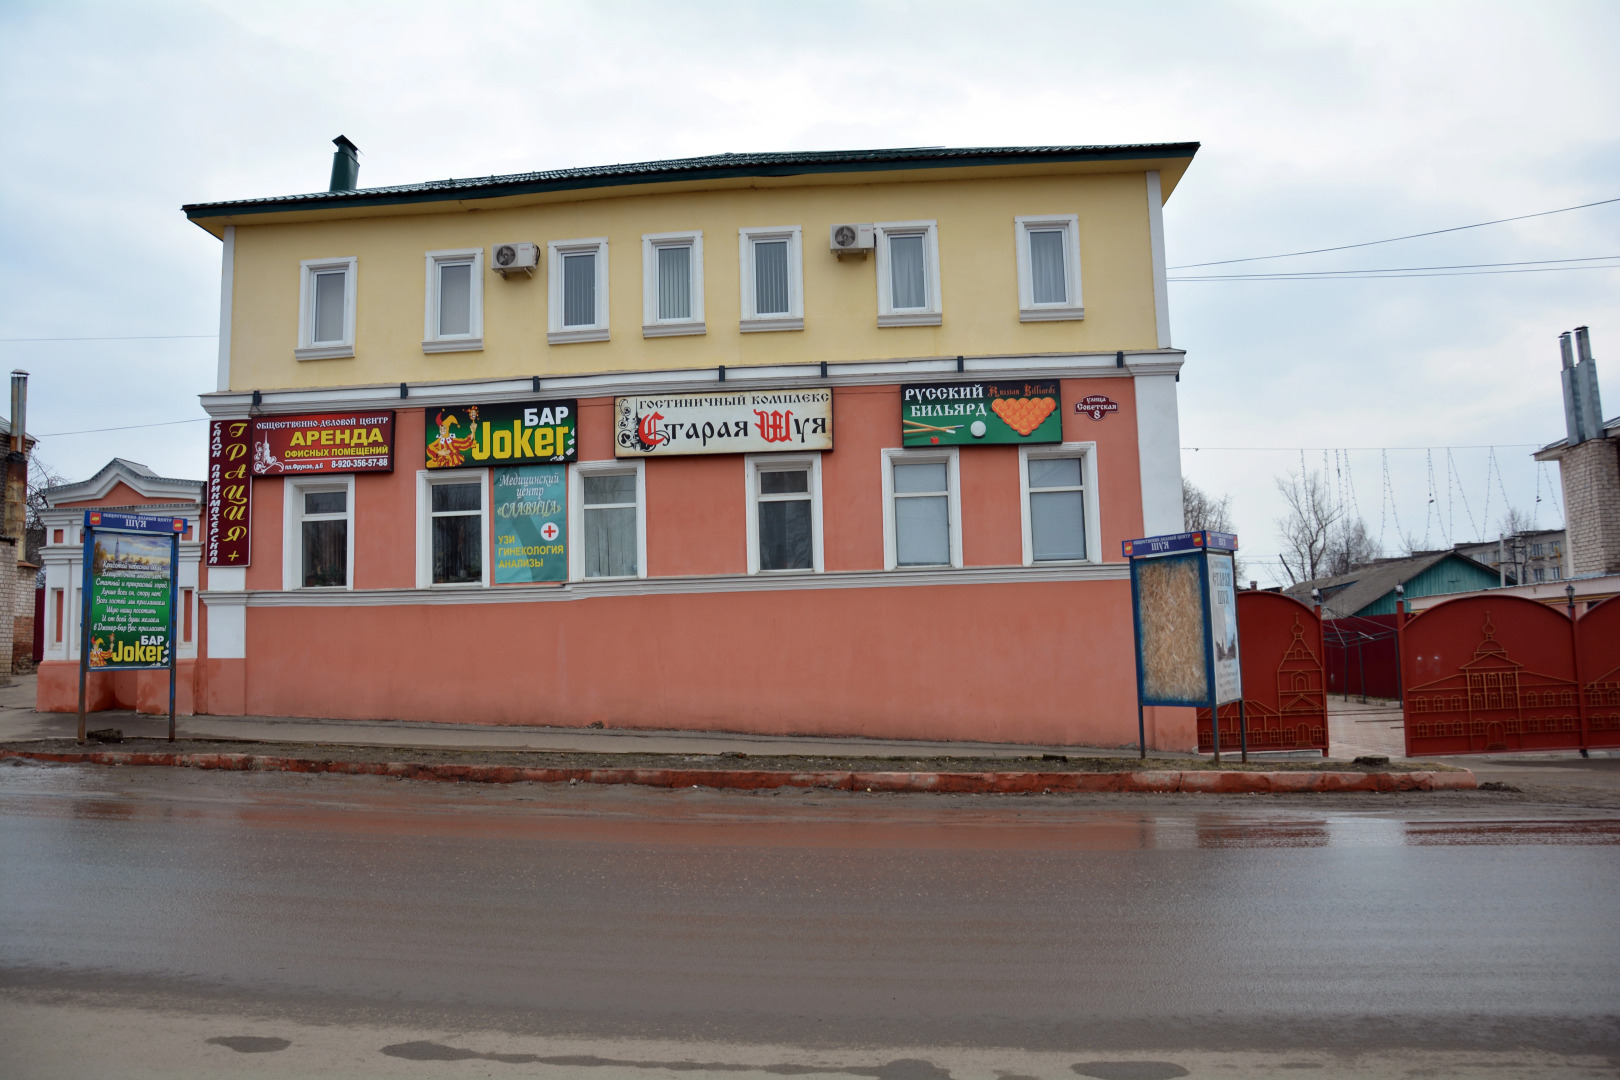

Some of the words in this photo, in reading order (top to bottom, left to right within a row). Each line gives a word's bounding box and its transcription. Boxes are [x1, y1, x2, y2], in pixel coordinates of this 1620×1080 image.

[904, 384, 984, 404] РУССКИЙ
[987, 385, 1020, 398] Russian
[1023, 383, 1056, 397] Billiards
[639, 394, 746, 409] ГОСТИНИЧНЫЙ
[751, 392, 830, 406] КОМПЛЕКС
[524, 406, 569, 427] БАР
[910, 403, 987, 418] БИЛЬЯРД
[1093, 410, 1101, 419] 8
[256, 417, 356, 430] ОБЩЕСТВЕННО-ДЕЛОВОЙ
[359, 416, 389, 426] ЦЕНТР
[638, 411, 749, 447] Старая
[753, 408, 827, 443] Шуя
[211, 422, 223, 458] САЛОН
[289, 427, 384, 447] АРЕНДА
[471, 419, 569, 461] Joker
[284, 448, 329, 458] ОФИСНЫХ
[331, 445, 388, 456] ПОМЕЩЕНИЙ
[331, 458, 388, 469] 8-920-356-57-88
[499, 472, 560, 487] Медицинский
[516, 487, 544, 499] центр
[209, 464, 221, 564] ПАРИКМАХЕРСКАЯ
[497, 500, 562, 518] «СЛАВИЦА»
[125, 519, 147, 529] ШУЯ
[498, 535, 515, 544] УЗИ
[1151, 542, 1169, 552] ШУЯ
[498, 545, 564, 557] ГИНЕКОЛОГИЯ
[498, 558, 544, 569] АНАЛИЗЫ
[140, 635, 165, 646] БАР
[112, 640, 165, 662] Joker
